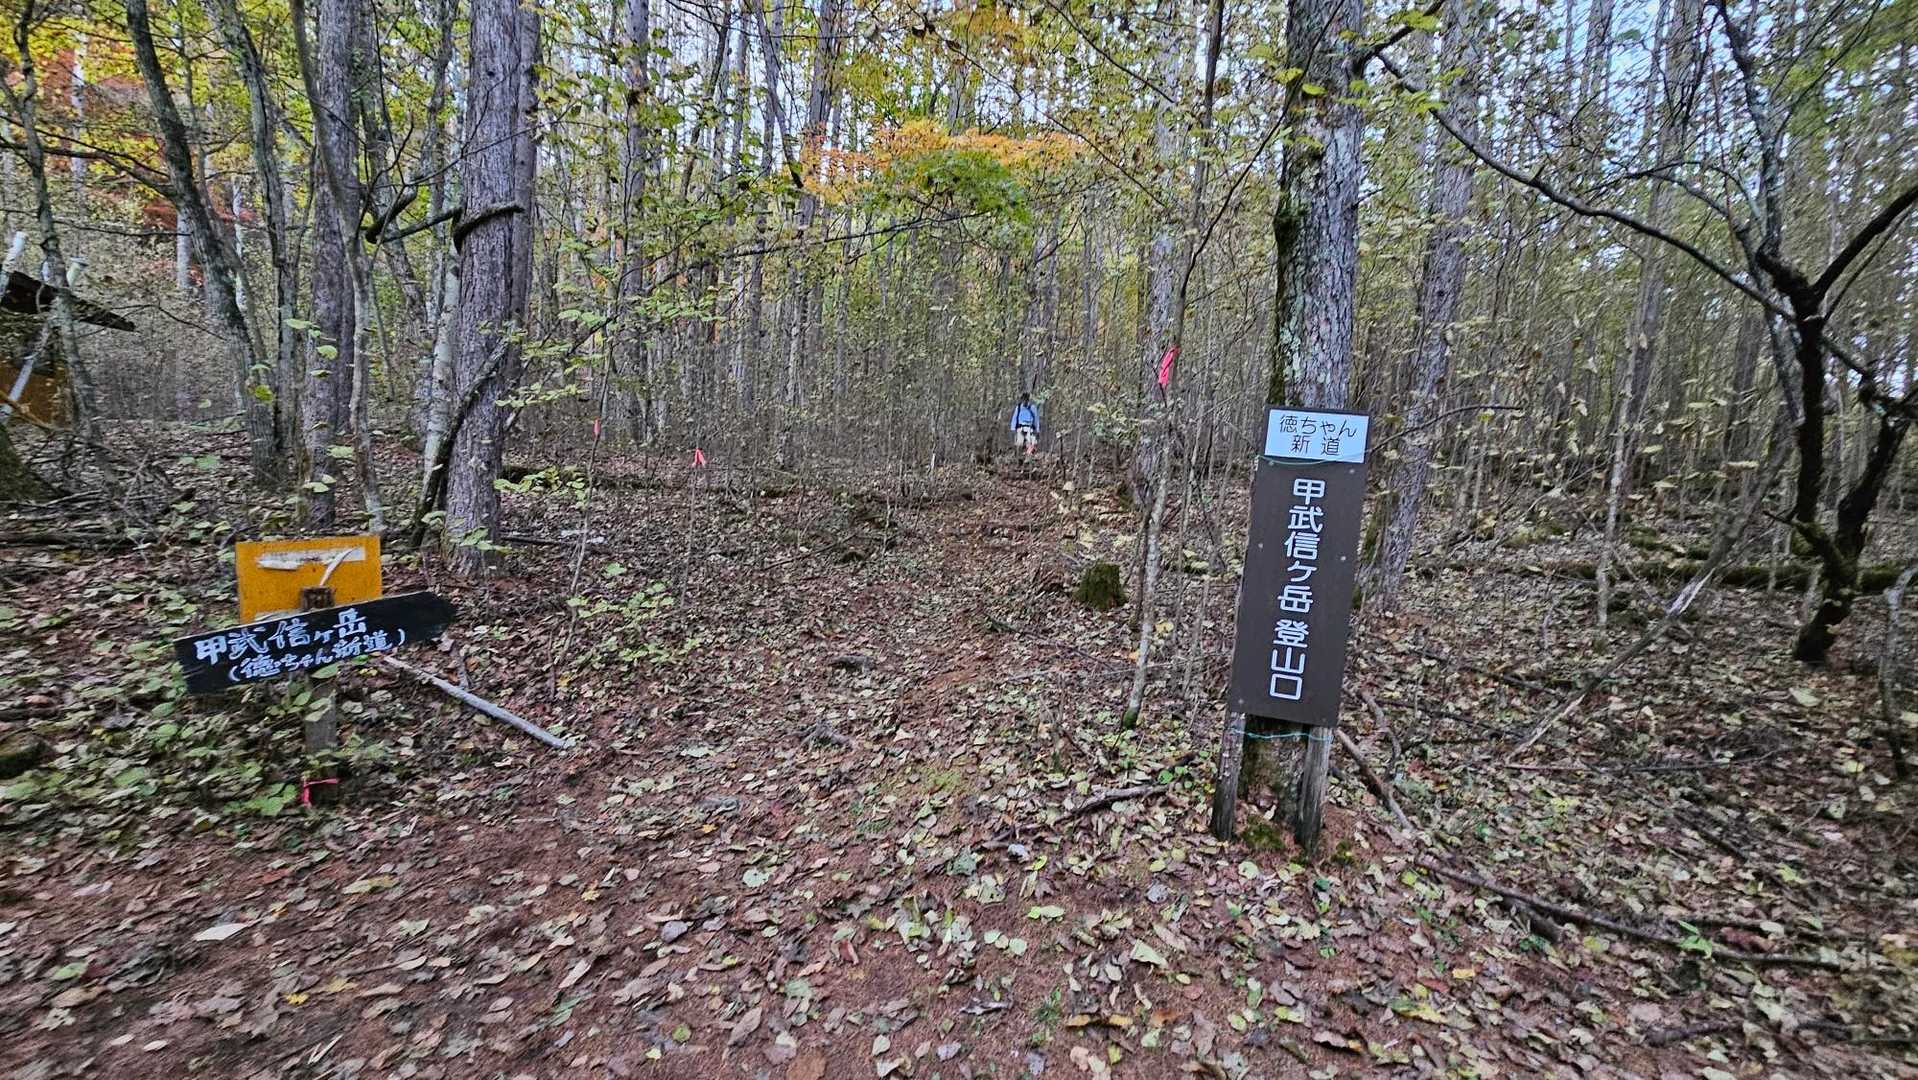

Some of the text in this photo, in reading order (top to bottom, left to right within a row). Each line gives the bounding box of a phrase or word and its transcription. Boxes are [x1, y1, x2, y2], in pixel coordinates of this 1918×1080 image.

[1279, 413, 1358, 438] 徳ちゃん
[1289, 434, 1341, 456] 新道
